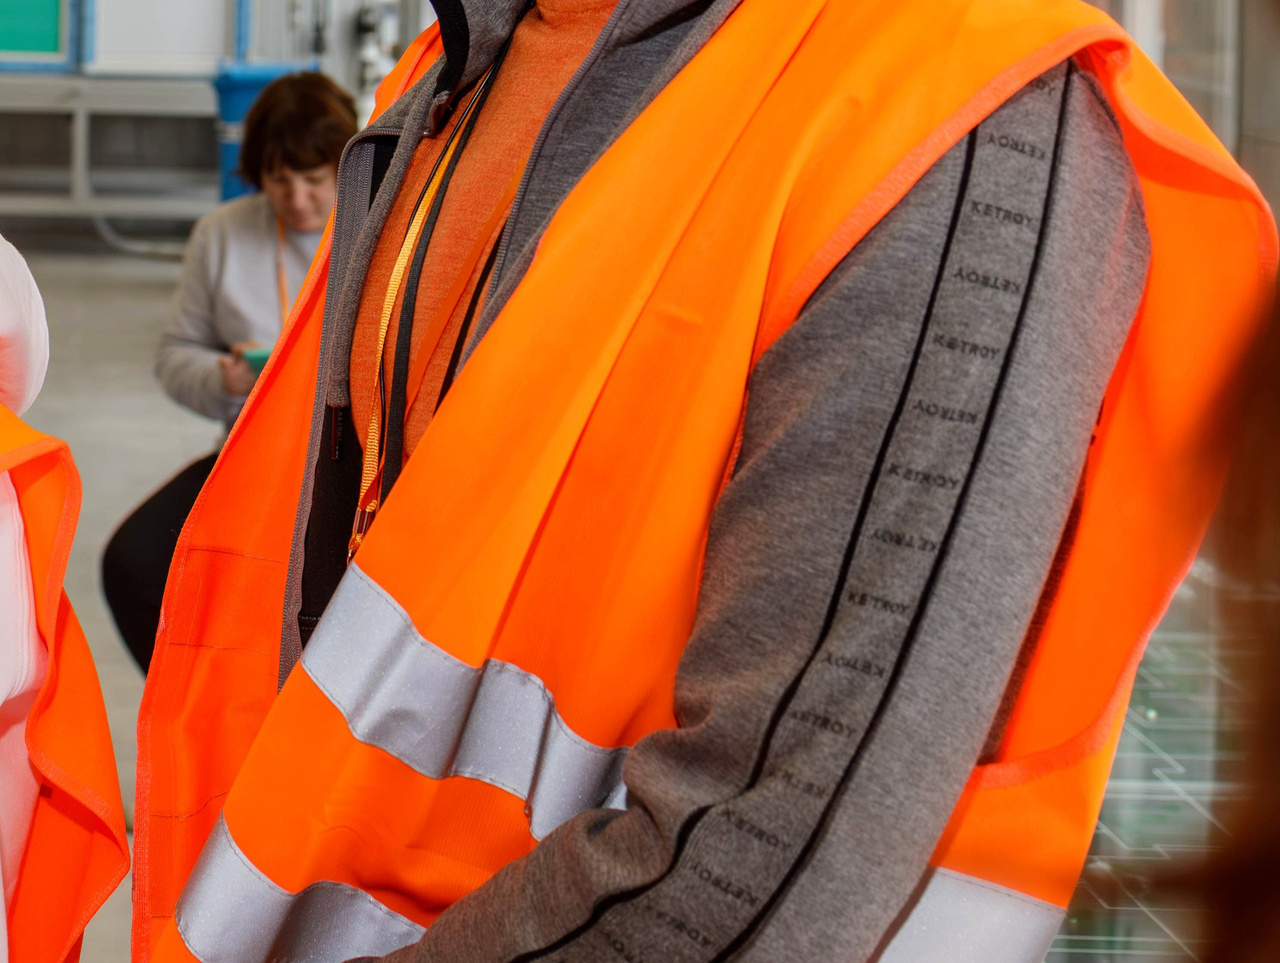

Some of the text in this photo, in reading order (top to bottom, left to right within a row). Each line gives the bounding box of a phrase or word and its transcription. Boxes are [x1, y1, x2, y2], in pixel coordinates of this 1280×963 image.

[986, 133, 1047, 161] KETROY
[971, 200, 1033, 226] KETROY
[954, 267, 1021, 293] KETROY
[932, 333, 1001, 360] KETROY
[912, 399, 979, 425] KETROY
[887, 462, 960, 490] KETROY
[847, 591, 911, 615] KETROY
